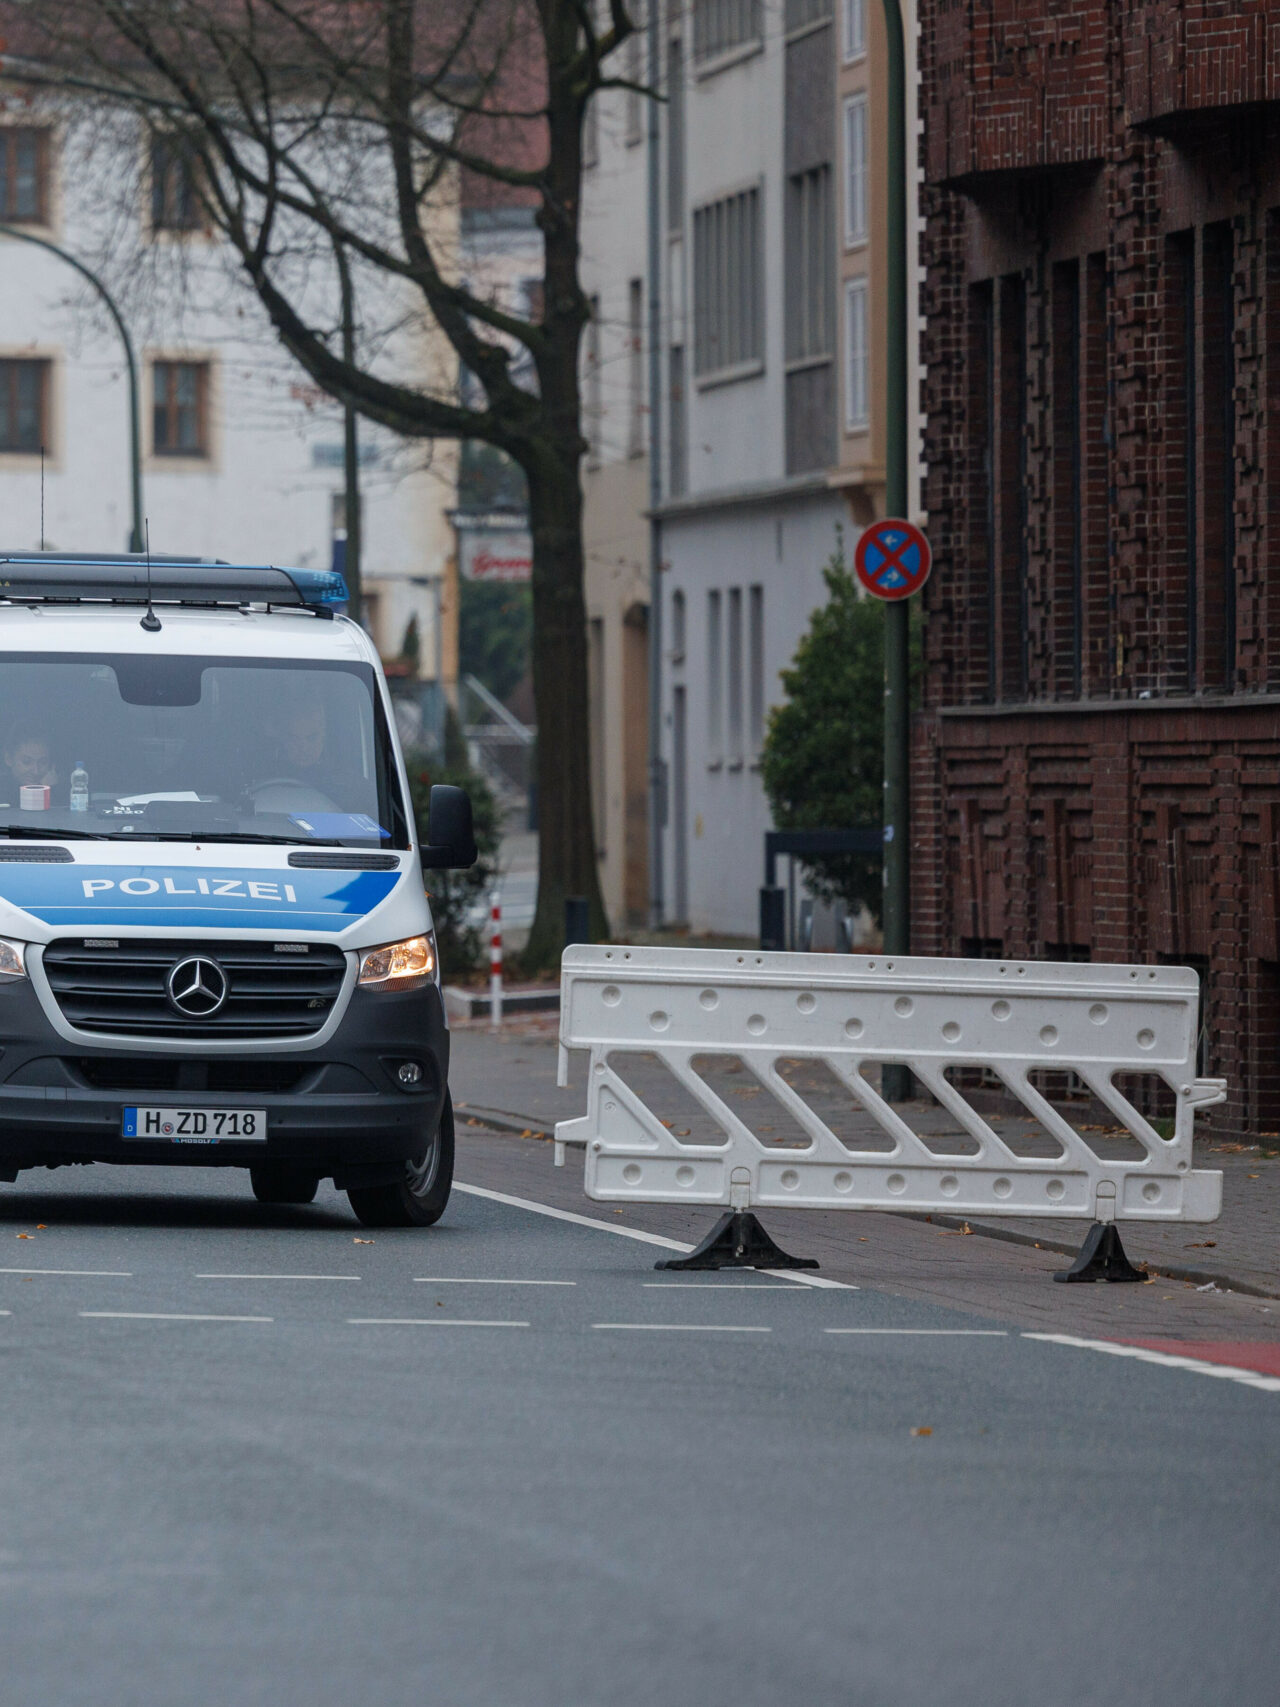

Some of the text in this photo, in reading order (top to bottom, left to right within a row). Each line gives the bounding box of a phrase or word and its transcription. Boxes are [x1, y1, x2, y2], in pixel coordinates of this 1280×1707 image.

[81, 877, 297, 902] POLIZEI
[145, 1111, 256, 1135] H ZD 718
